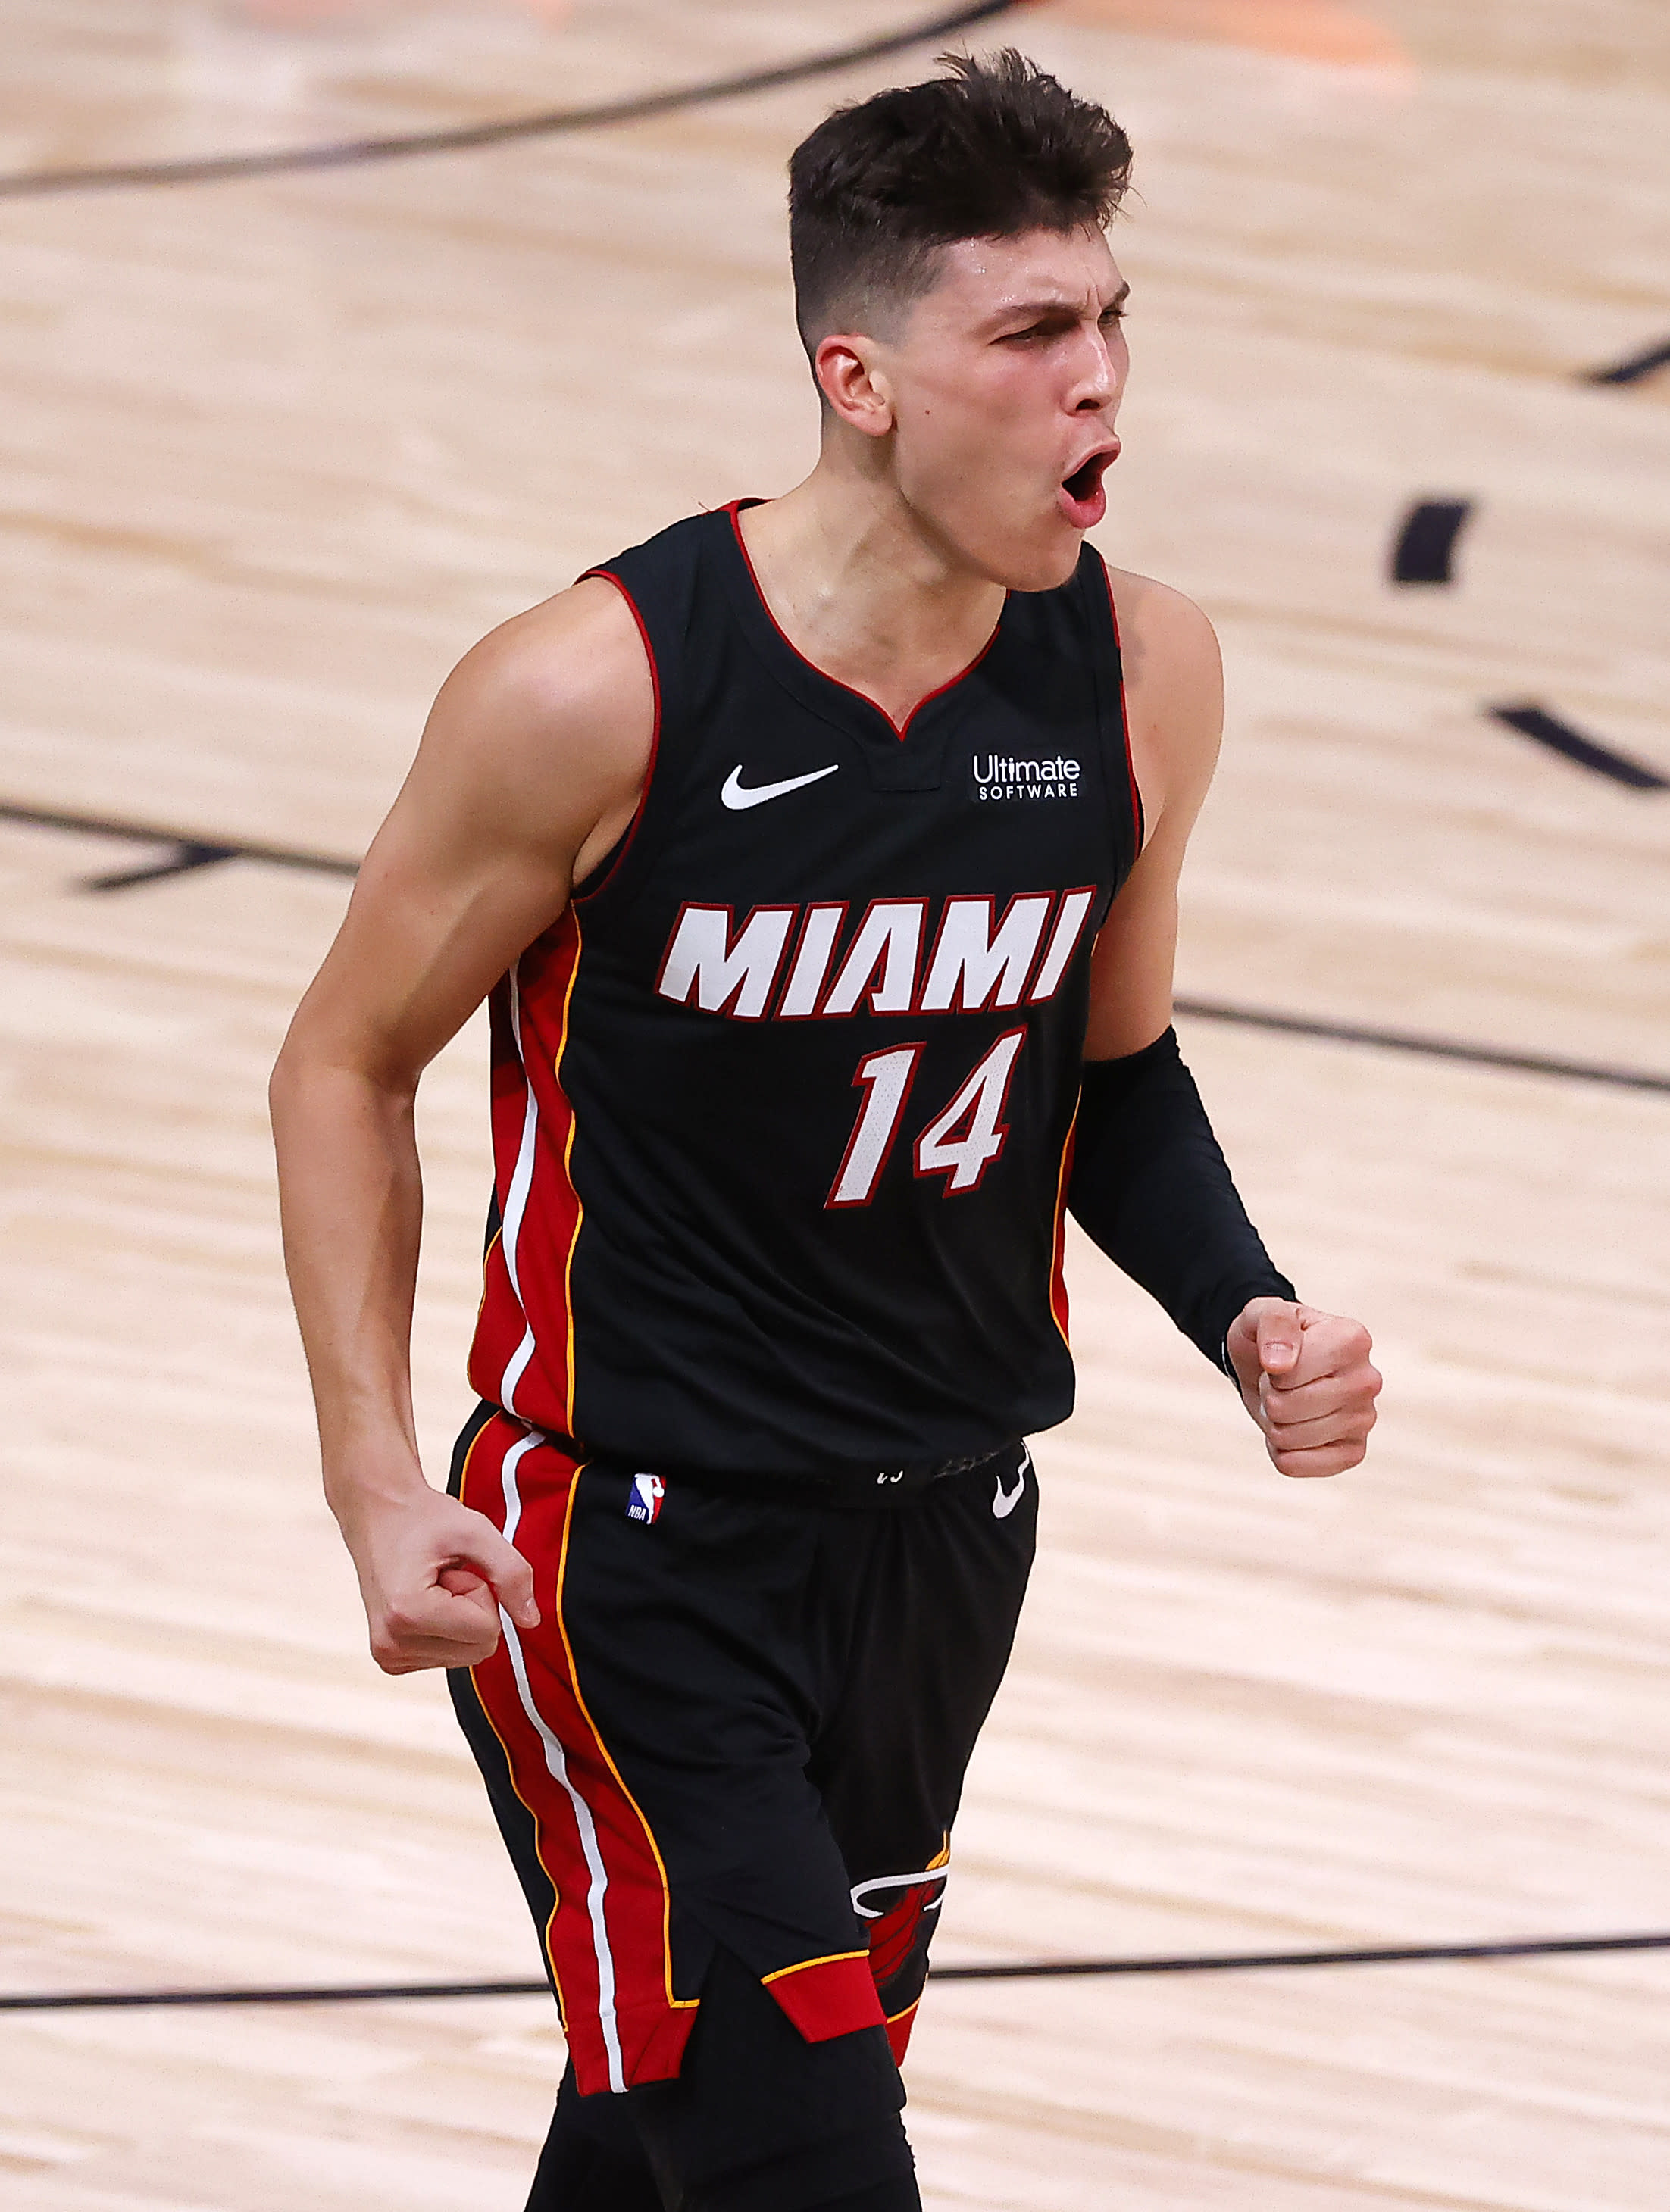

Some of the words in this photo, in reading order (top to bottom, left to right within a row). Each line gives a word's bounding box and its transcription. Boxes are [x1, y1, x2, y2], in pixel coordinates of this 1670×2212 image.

[974, 754, 1080, 783] Ultimate
[978, 783, 1078, 800] SOFTWARE
[656, 885, 1097, 1020] MIAMI
[824, 1024, 1027, 1209] 14
[627, 1504, 646, 1521] NBA
